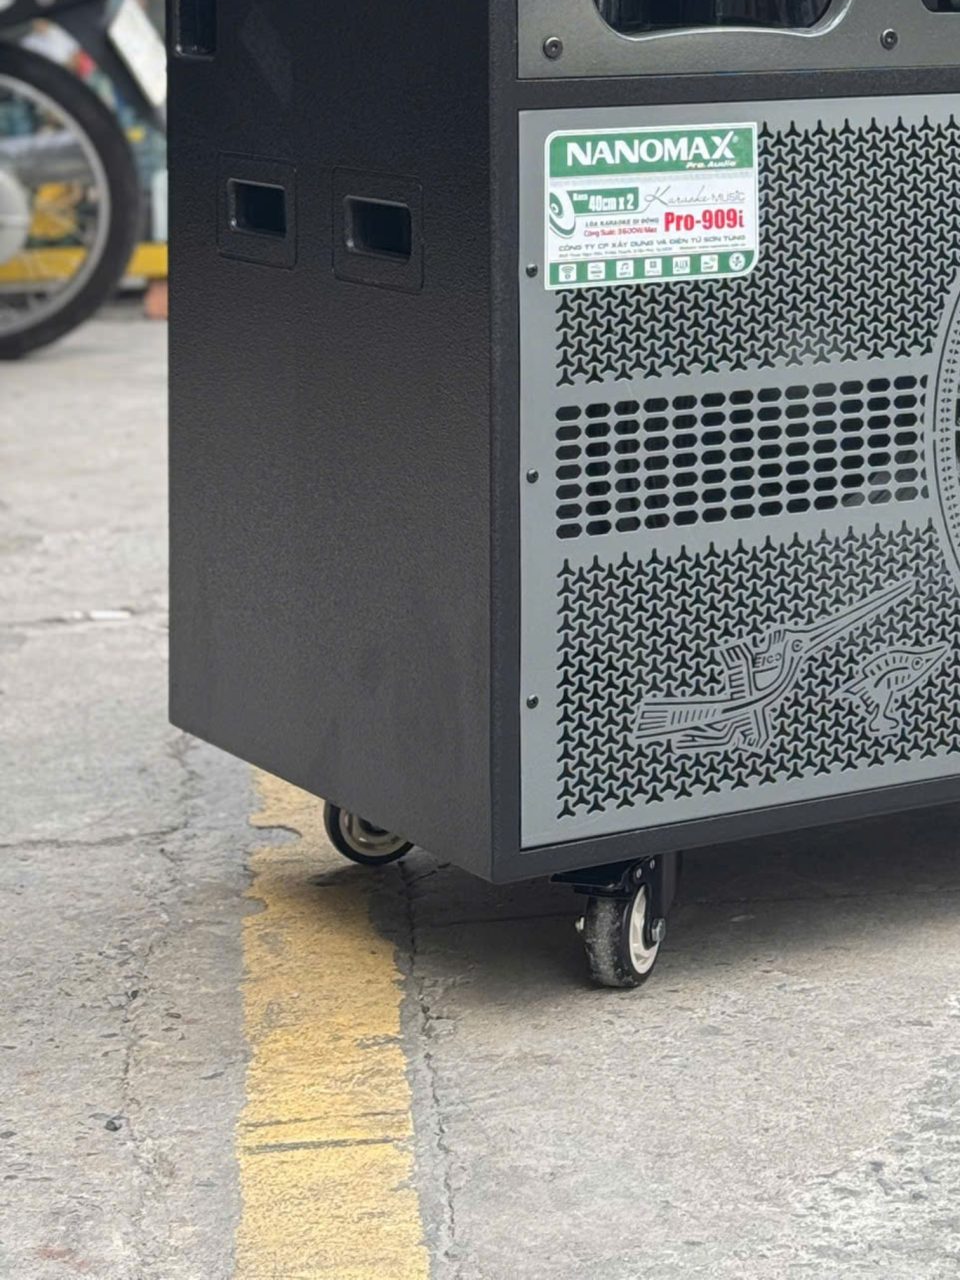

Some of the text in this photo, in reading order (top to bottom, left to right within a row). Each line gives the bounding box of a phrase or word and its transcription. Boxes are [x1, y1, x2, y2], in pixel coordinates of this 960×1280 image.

[566, 130, 736, 167] NANOMAX
[707, 160, 737, 168] Audio
[588, 195, 617, 211] 40cm
[664, 208, 744, 232] Pro-909i
